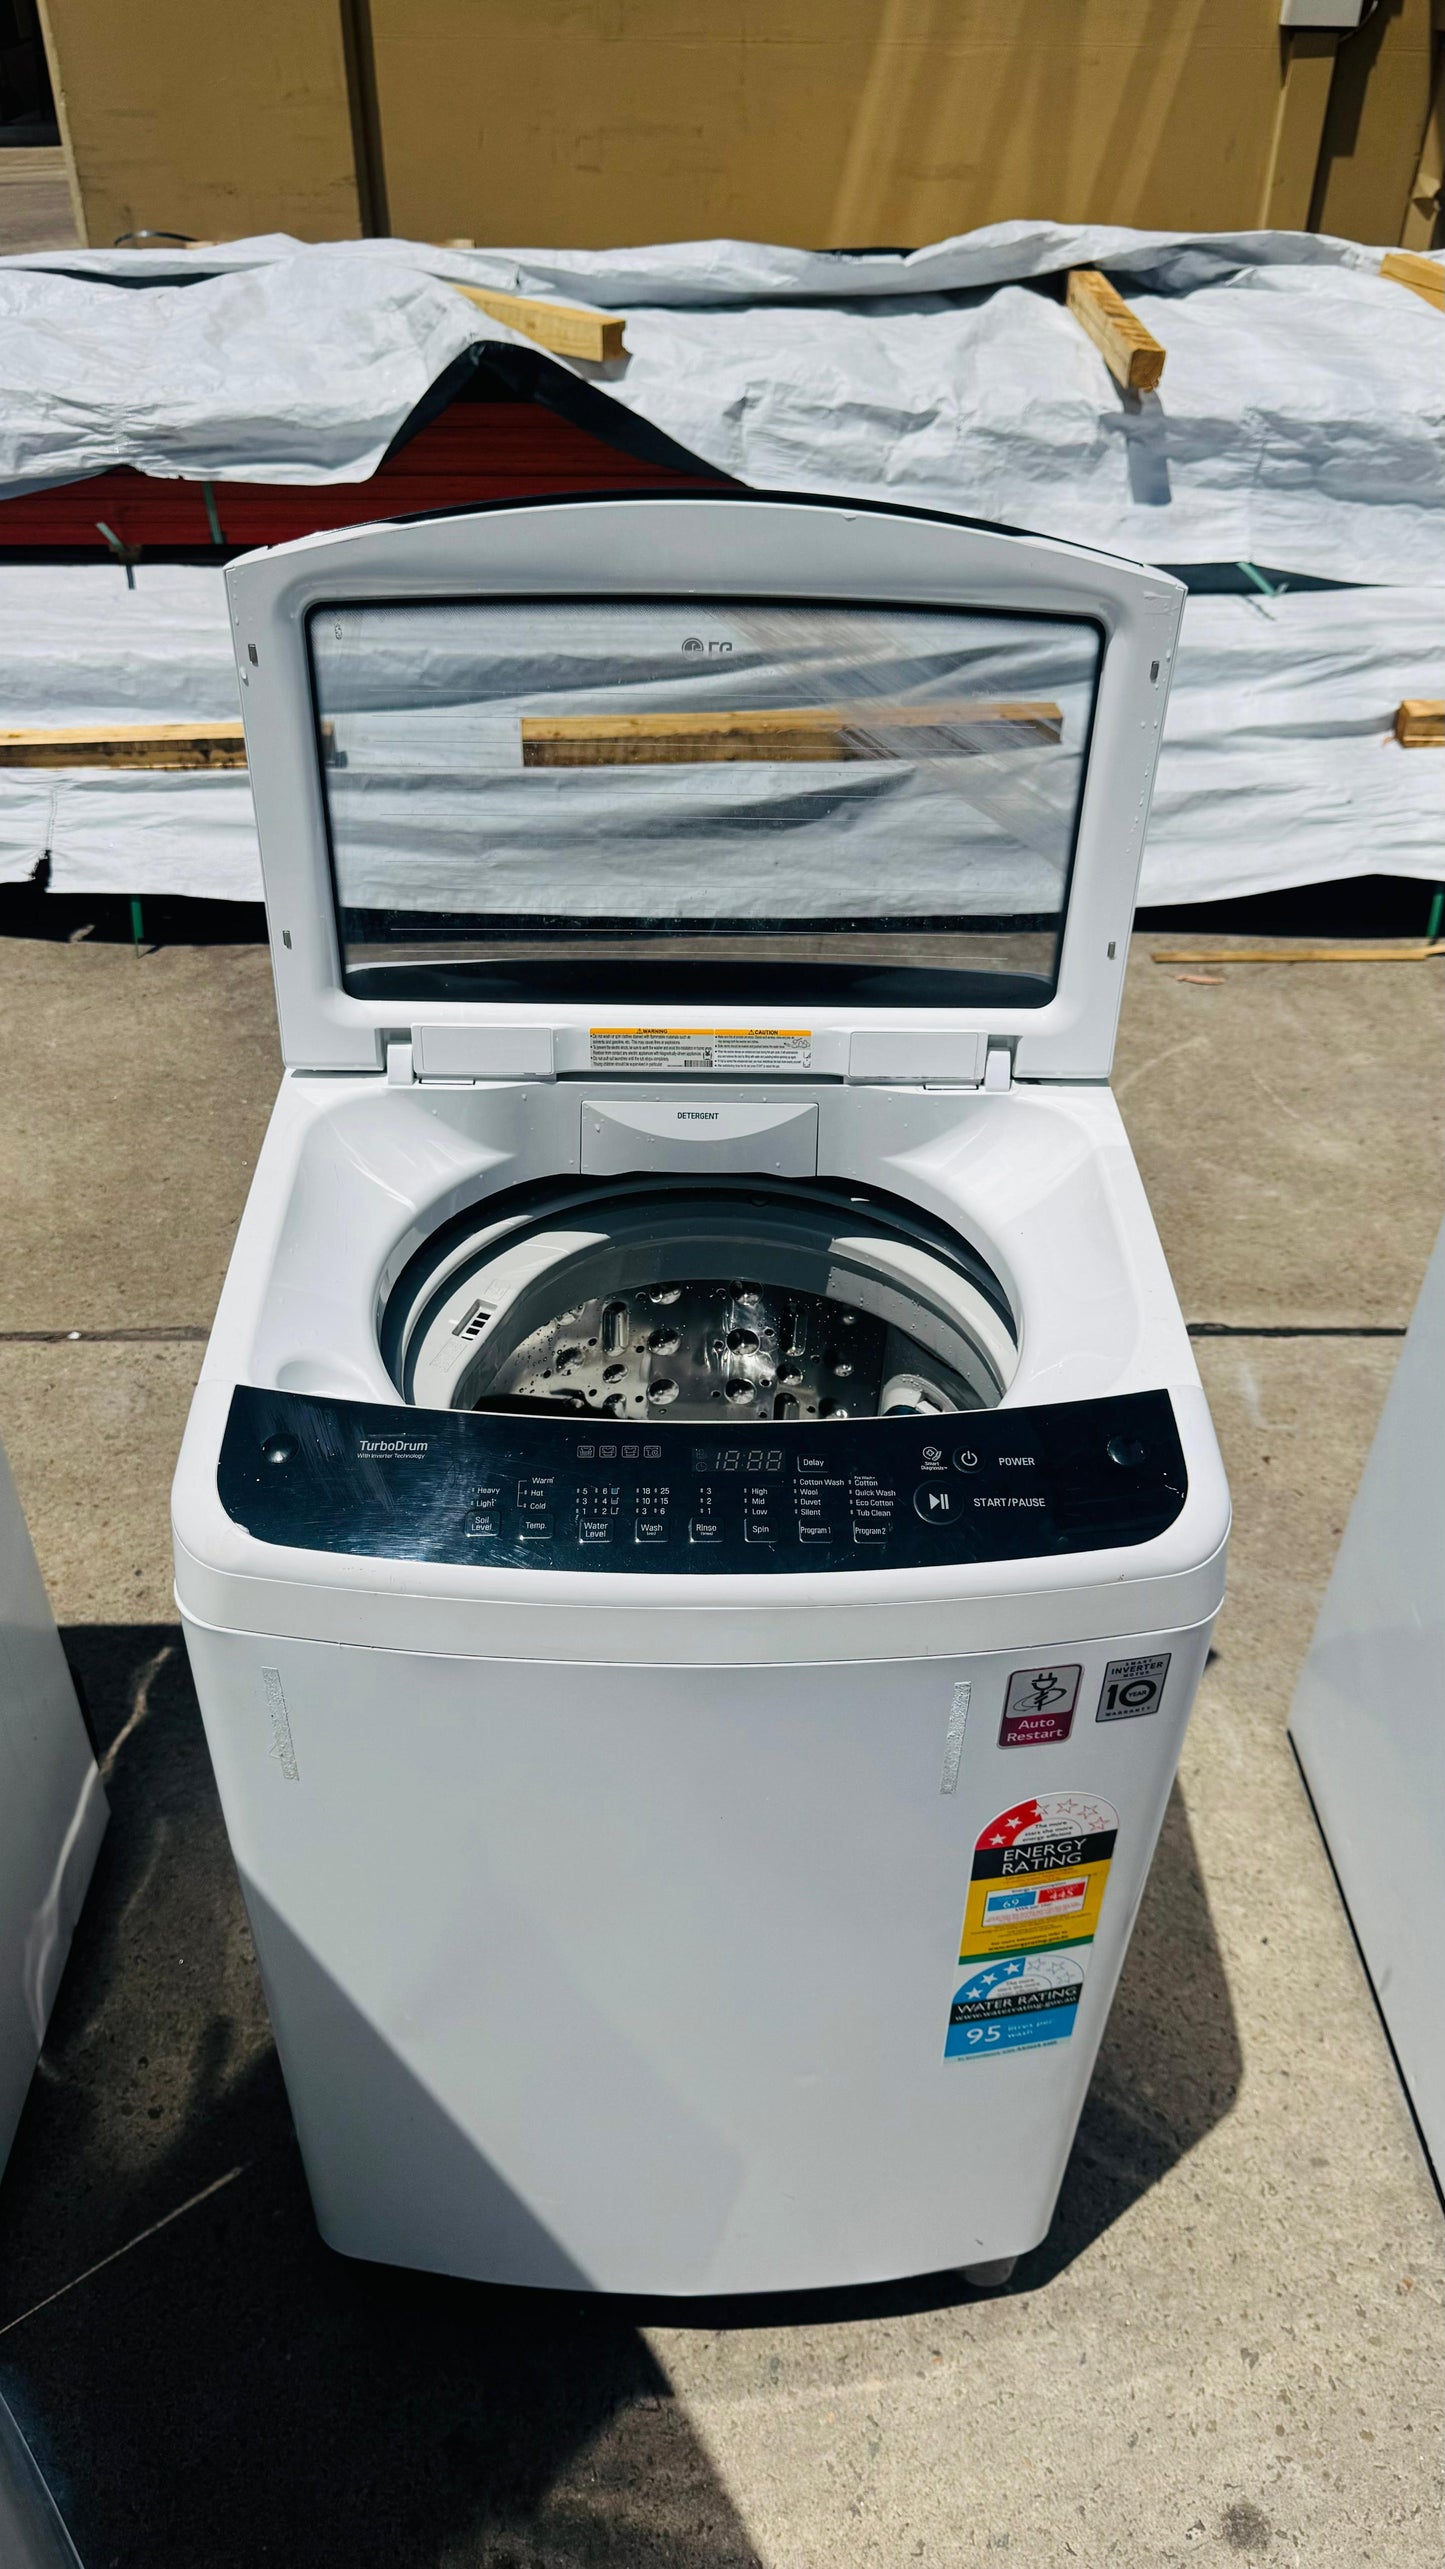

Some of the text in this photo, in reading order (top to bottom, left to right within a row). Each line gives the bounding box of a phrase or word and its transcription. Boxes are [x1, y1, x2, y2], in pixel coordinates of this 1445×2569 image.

[360, 1441, 428, 1451] TurboDrum
[804, 1459, 825, 1467] Delay
[999, 1458, 1035, 1466] POWER
[752, 1488, 768, 1496] High
[974, 1498, 1046, 1507] START/PAUSE
[584, 1522, 608, 1530] Water
[641, 1524, 663, 1532] Wash
[696, 1524, 717, 1532] Rinse
[752, 1525, 770, 1535] Spin
[585, 1530, 607, 1538] Level
[1112, 1662, 1163, 1675] INVERTER
[1106, 1680, 1157, 1710] 10
[1018, 1720, 1056, 1730] Auto
[1007, 1728, 1064, 1742] Restart
[1004, 1838, 1087, 1862] ENERGY
[1002, 1852, 1082, 1875] RATING
[958, 1999, 1012, 2014] WATER
[1018, 1987, 1078, 2007] RATING
[967, 2025, 1001, 2045] 95
